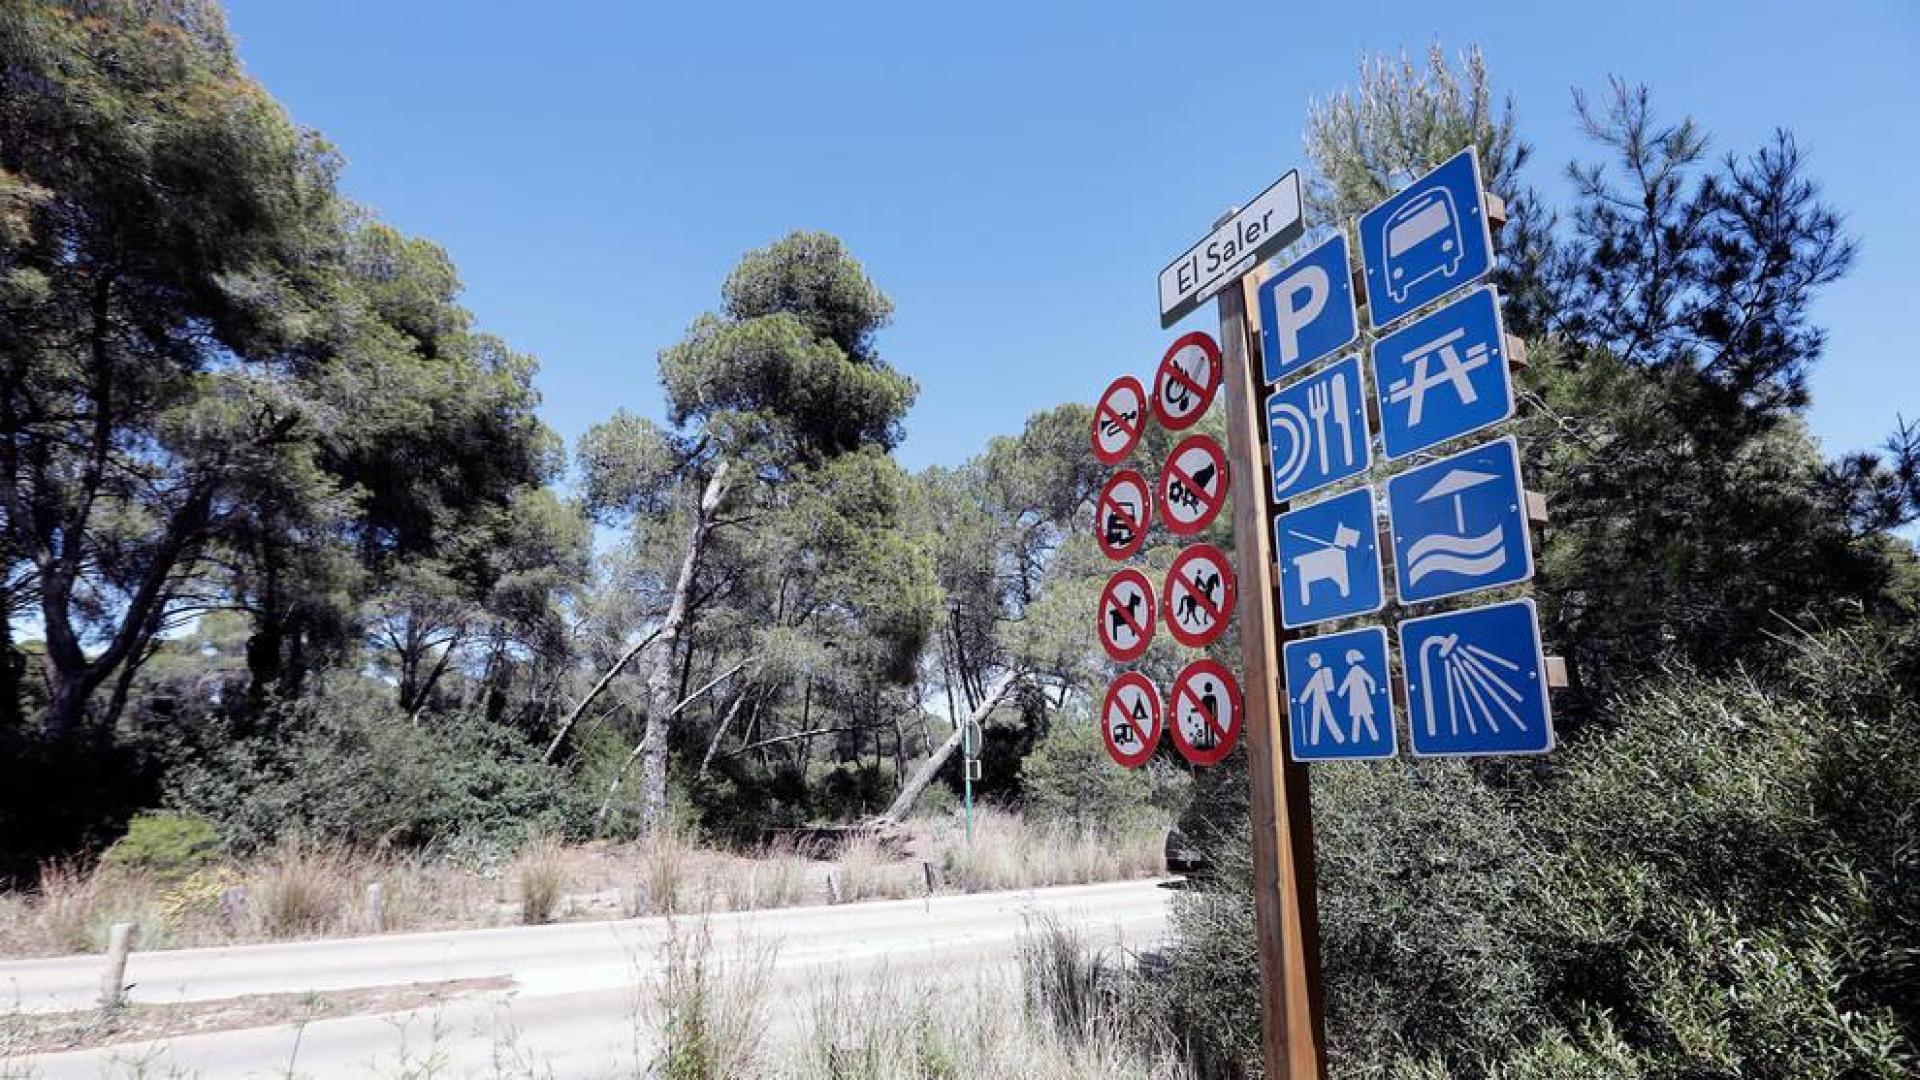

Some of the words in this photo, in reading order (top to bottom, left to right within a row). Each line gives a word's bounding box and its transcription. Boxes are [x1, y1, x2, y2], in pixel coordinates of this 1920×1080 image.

[1177, 256, 1199, 295] El
[1206, 209, 1273, 272] Saler
[1273, 265, 1329, 366] P
